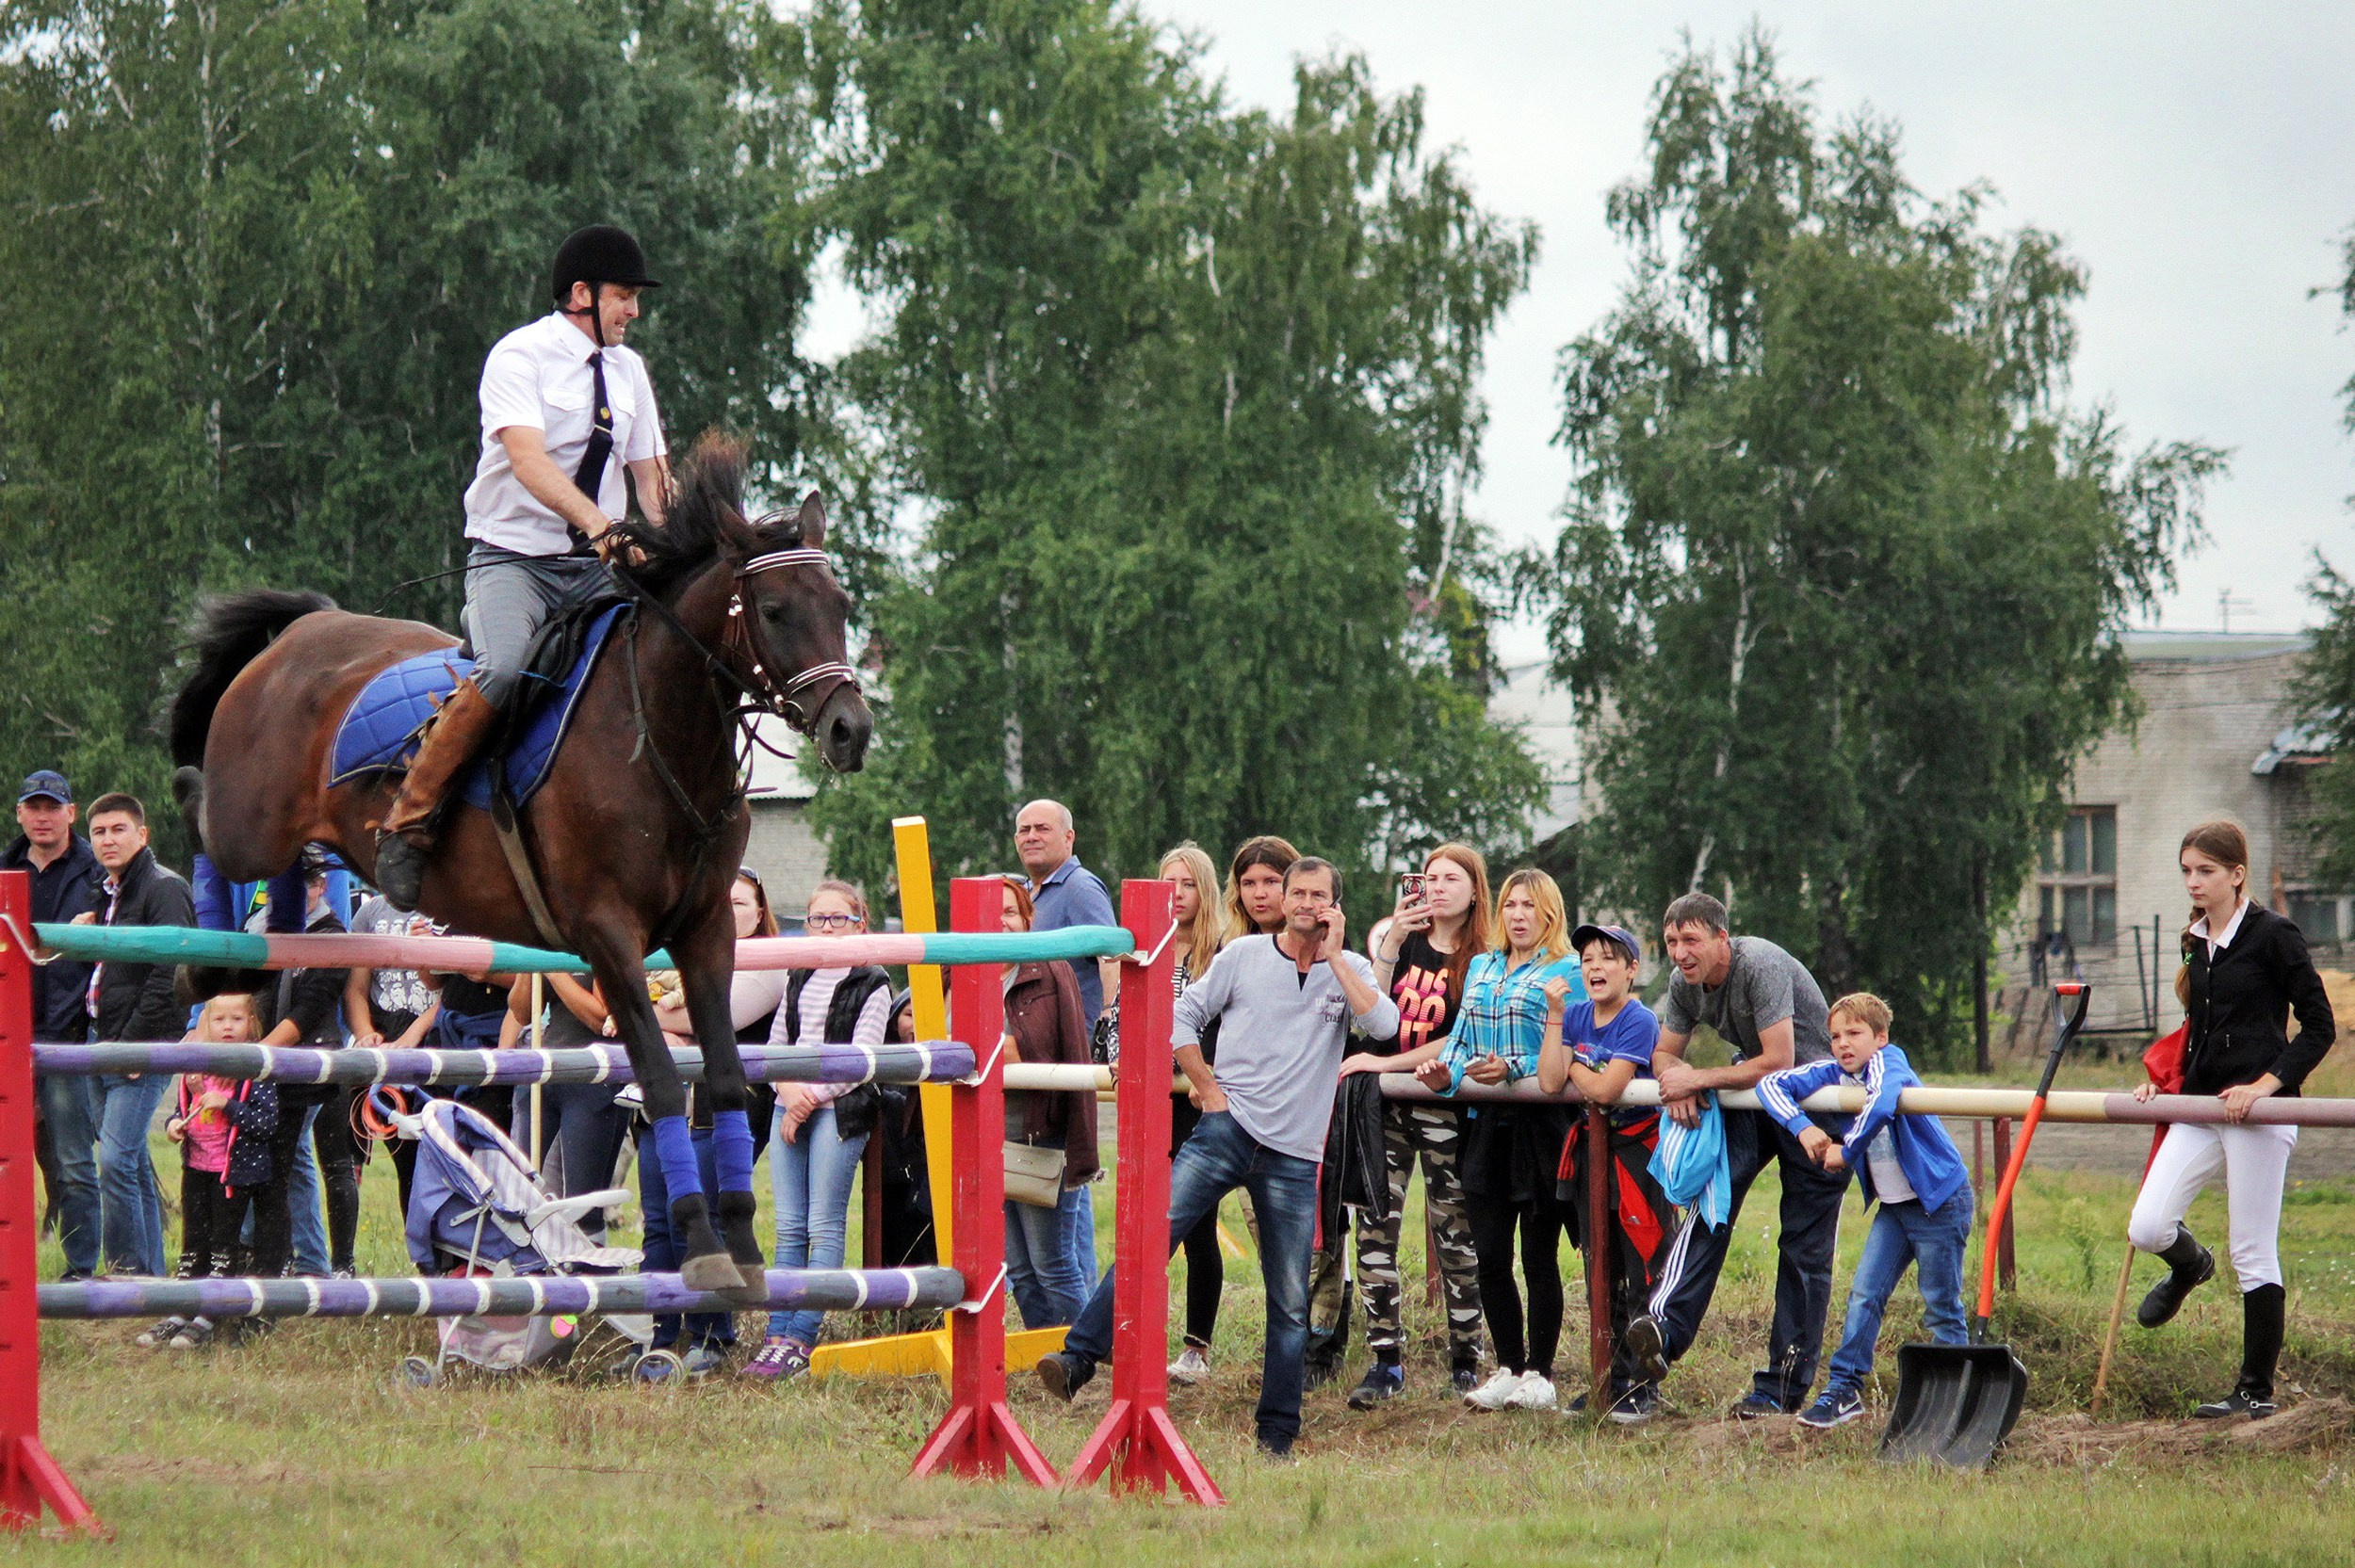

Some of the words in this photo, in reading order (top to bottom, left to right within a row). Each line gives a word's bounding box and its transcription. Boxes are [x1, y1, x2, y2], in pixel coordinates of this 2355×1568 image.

[378, 971, 401, 983] TORM
[1397, 986, 1446, 1028] DO
[1400, 1019, 1434, 1054] IT
